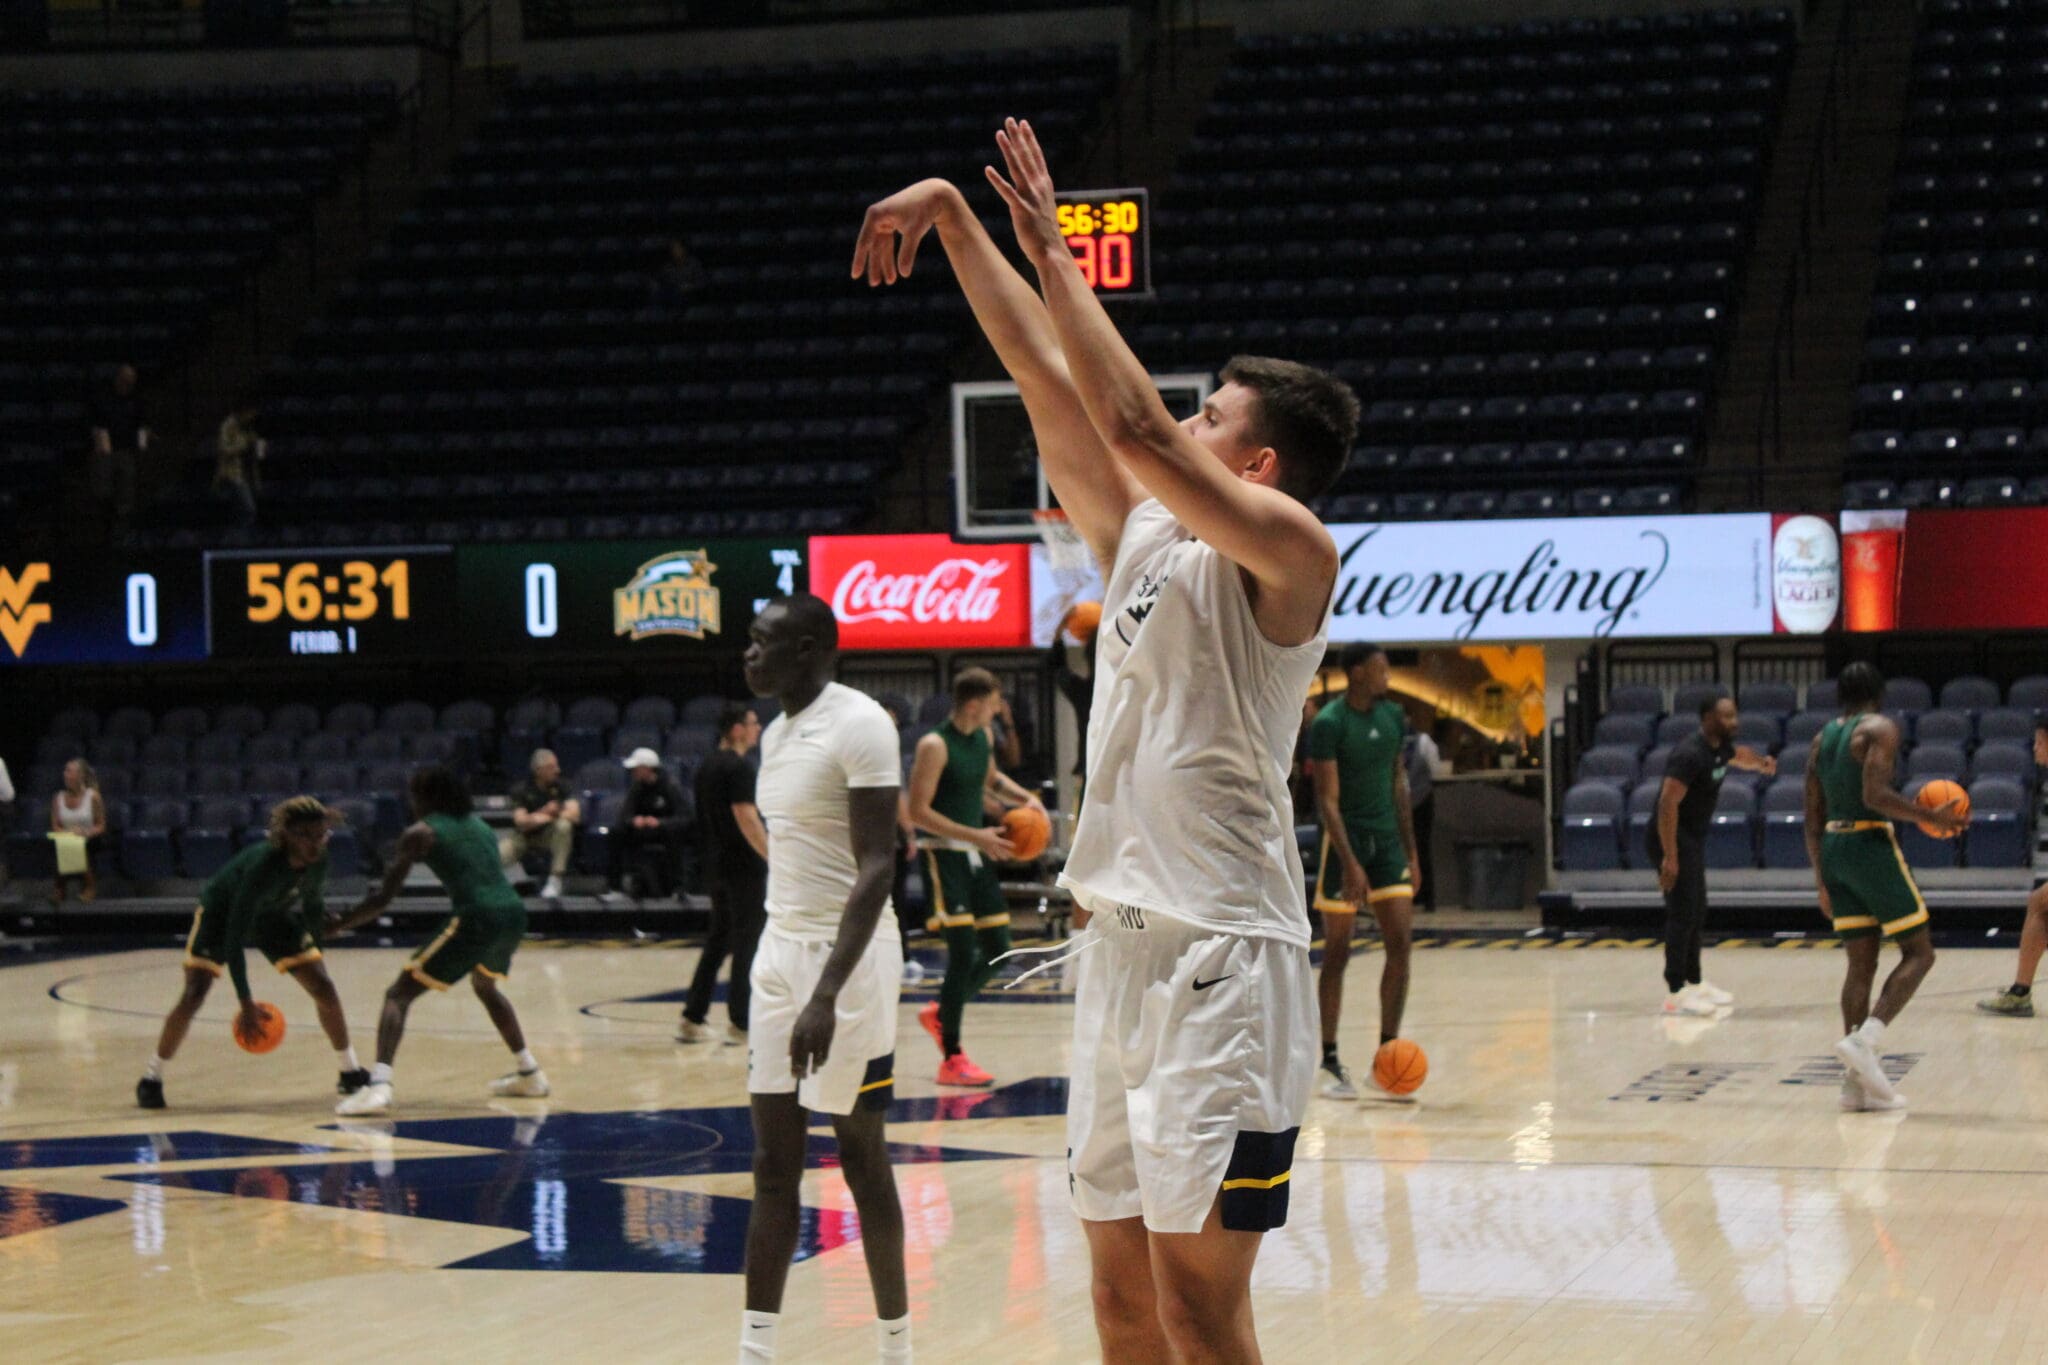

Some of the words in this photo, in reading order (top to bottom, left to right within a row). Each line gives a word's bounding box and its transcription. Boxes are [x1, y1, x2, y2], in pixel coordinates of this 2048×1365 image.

[1057, 201, 1138, 236] 56:30
[127, 573, 157, 646] 0
[247, 560, 409, 622] 56:31
[525, 563, 558, 637] 0
[620, 588, 716, 624] MASON
[832, 559, 1010, 623] Coca-Cola
